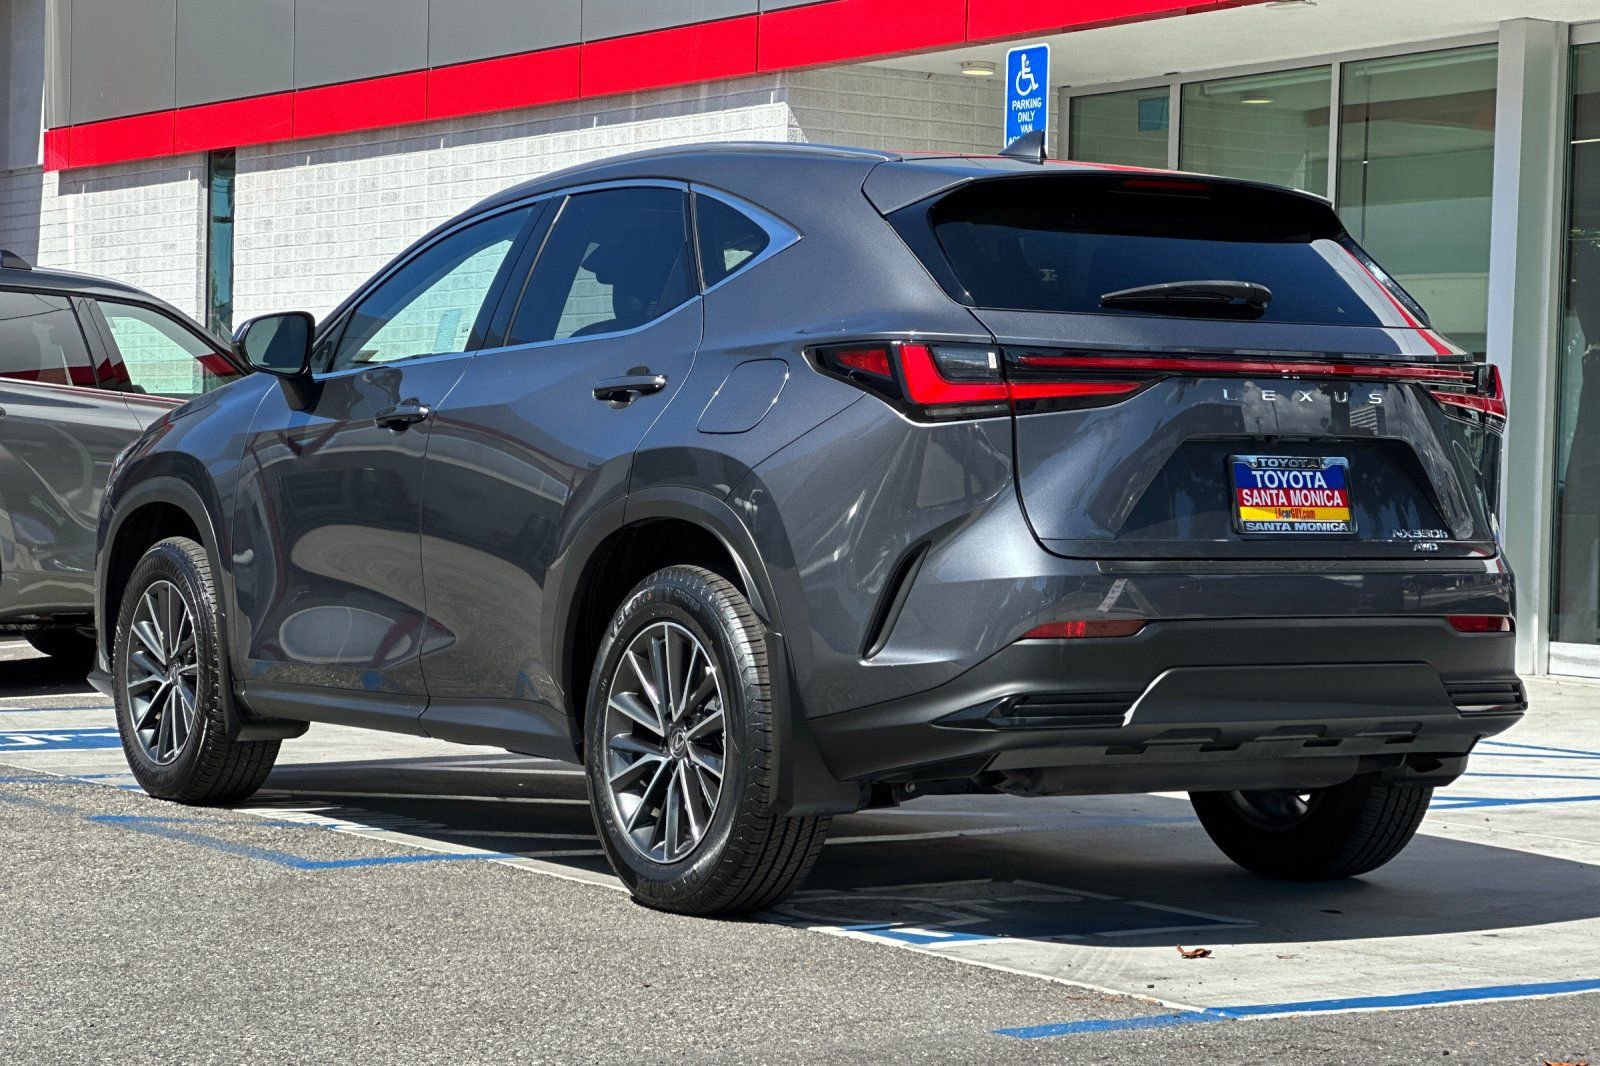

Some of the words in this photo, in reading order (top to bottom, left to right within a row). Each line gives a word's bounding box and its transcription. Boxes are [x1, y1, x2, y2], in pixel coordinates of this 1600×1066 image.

[1012, 98, 1041, 110] PARKING
[1018, 111, 1035, 122] ONLY
[1020, 124, 1032, 133] VAN
[1223, 388, 1383, 404] LEXUS
[1257, 458, 1319, 468] TOYOTA
[1252, 471, 1328, 489] TOYOTA
[1242, 489, 1288, 506] SANTA
[1290, 489, 1344, 507] MONICA
[1246, 522, 1292, 531] SANTA
[1294, 522, 1349, 532] MONICA
[1413, 542, 1439, 552] AWD
